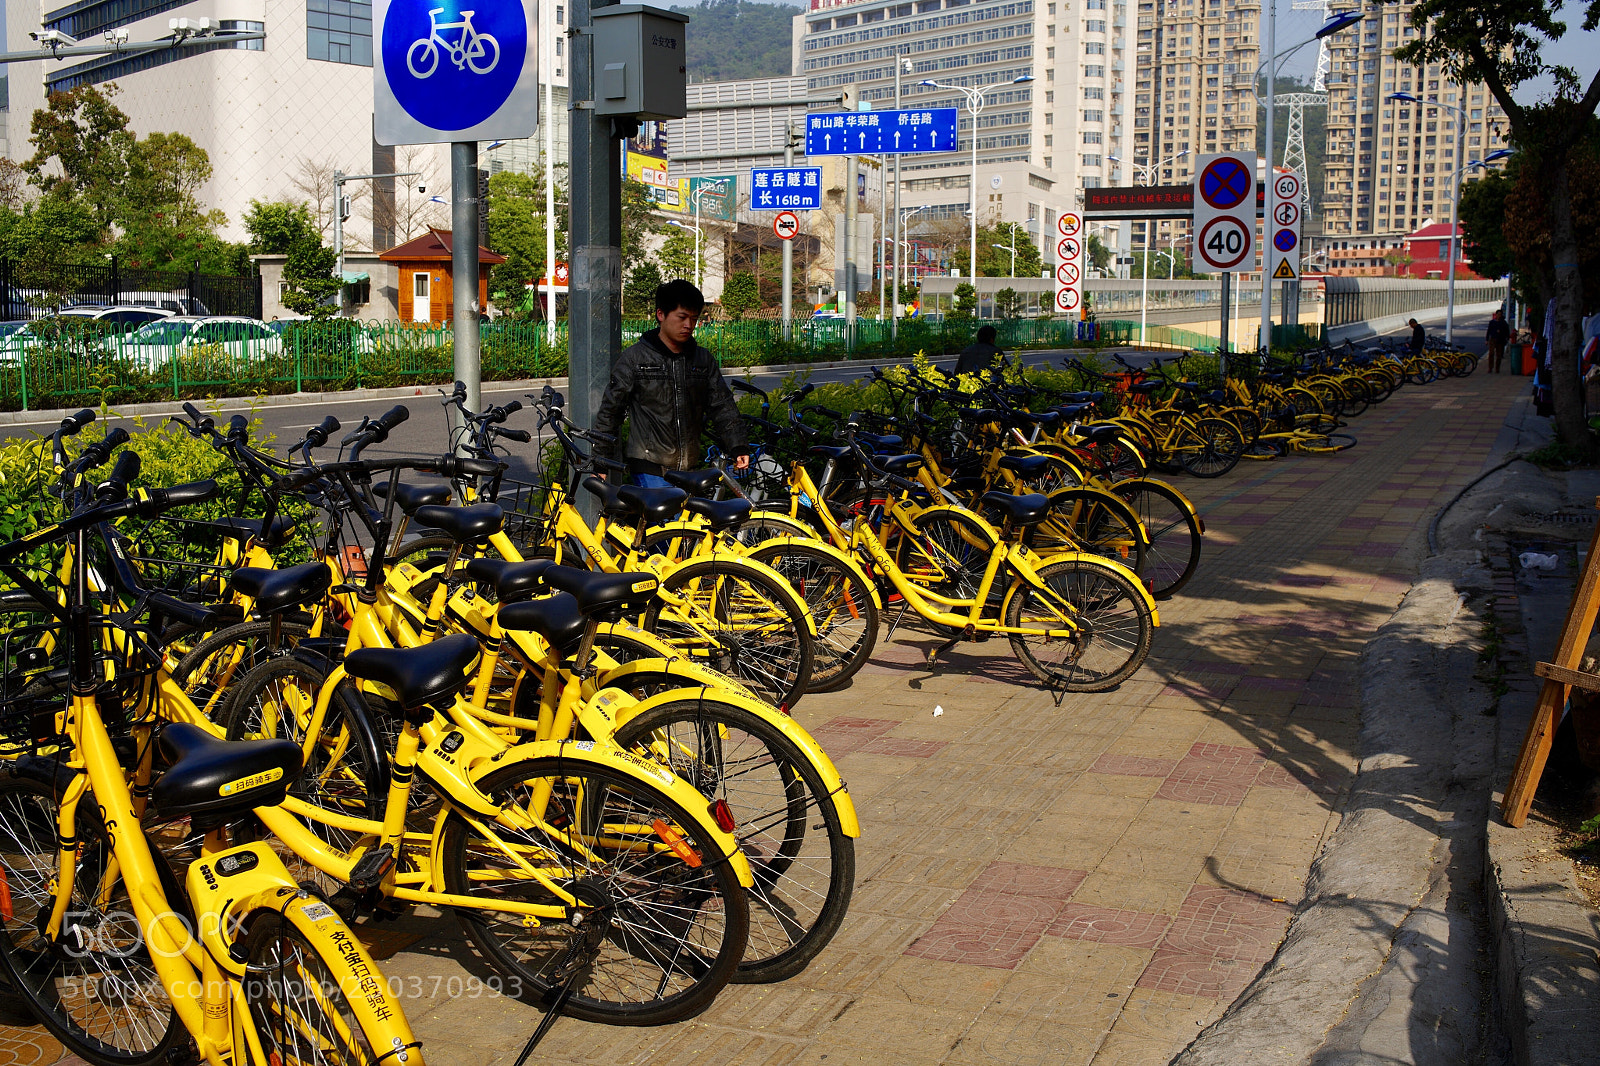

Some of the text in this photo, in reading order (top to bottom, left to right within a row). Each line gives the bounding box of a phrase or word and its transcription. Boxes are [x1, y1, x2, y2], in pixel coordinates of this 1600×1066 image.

[811, 112, 932, 129] 南山路 华荣路 侨岳路
[755, 171, 818, 188] 莲岳隧道
[1279, 181, 1294, 193] 60
[1207, 229, 1242, 255] 40
[587, 545, 603, 563] ofo
[875, 555, 891, 572] ofo
[235, 773, 273, 791] 扫码骑车
[329, 930, 394, 1022] 支付宝扫码骑车
